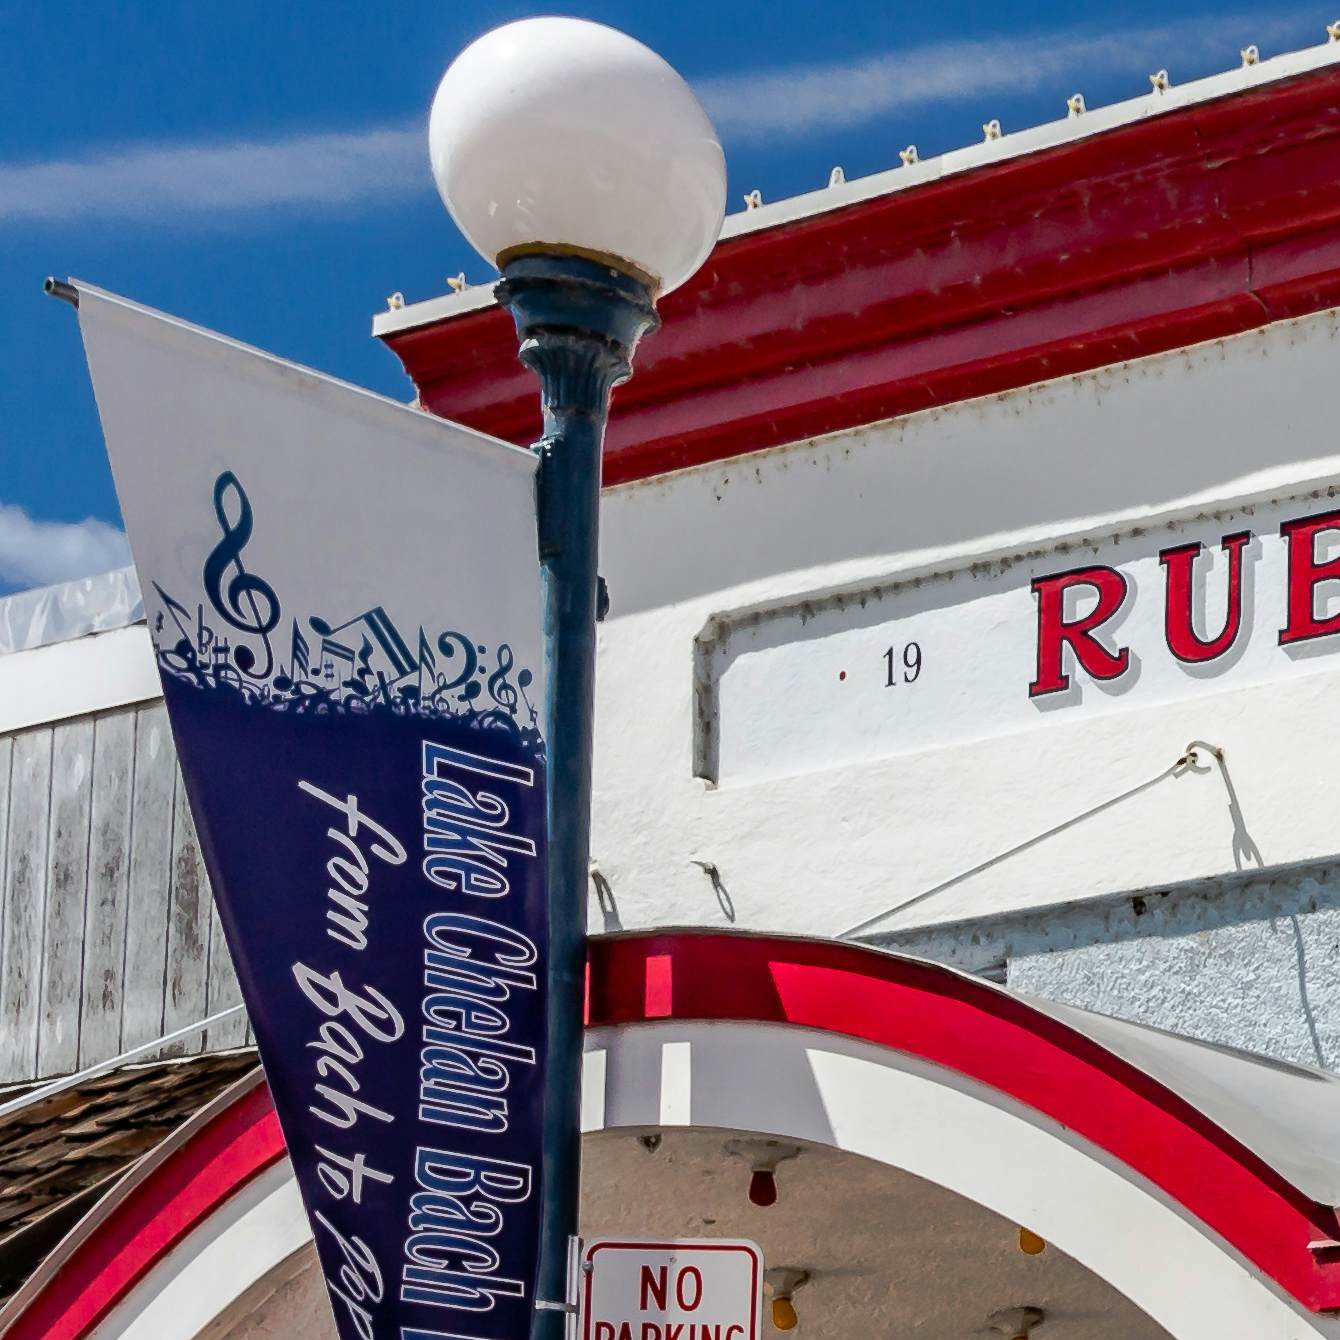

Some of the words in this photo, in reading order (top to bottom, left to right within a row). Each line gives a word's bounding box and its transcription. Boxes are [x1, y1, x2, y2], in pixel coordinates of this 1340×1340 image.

[882, 641, 922, 687] 19
[421, 739, 537, 898] Lake
[292, 961, 405, 1130] Bach
[418, 912, 538, 1132] Chelan
[314, 1144, 396, 1205] to
[399, 1146, 532, 1312] Bach
[639, 1264, 703, 1312] NO
